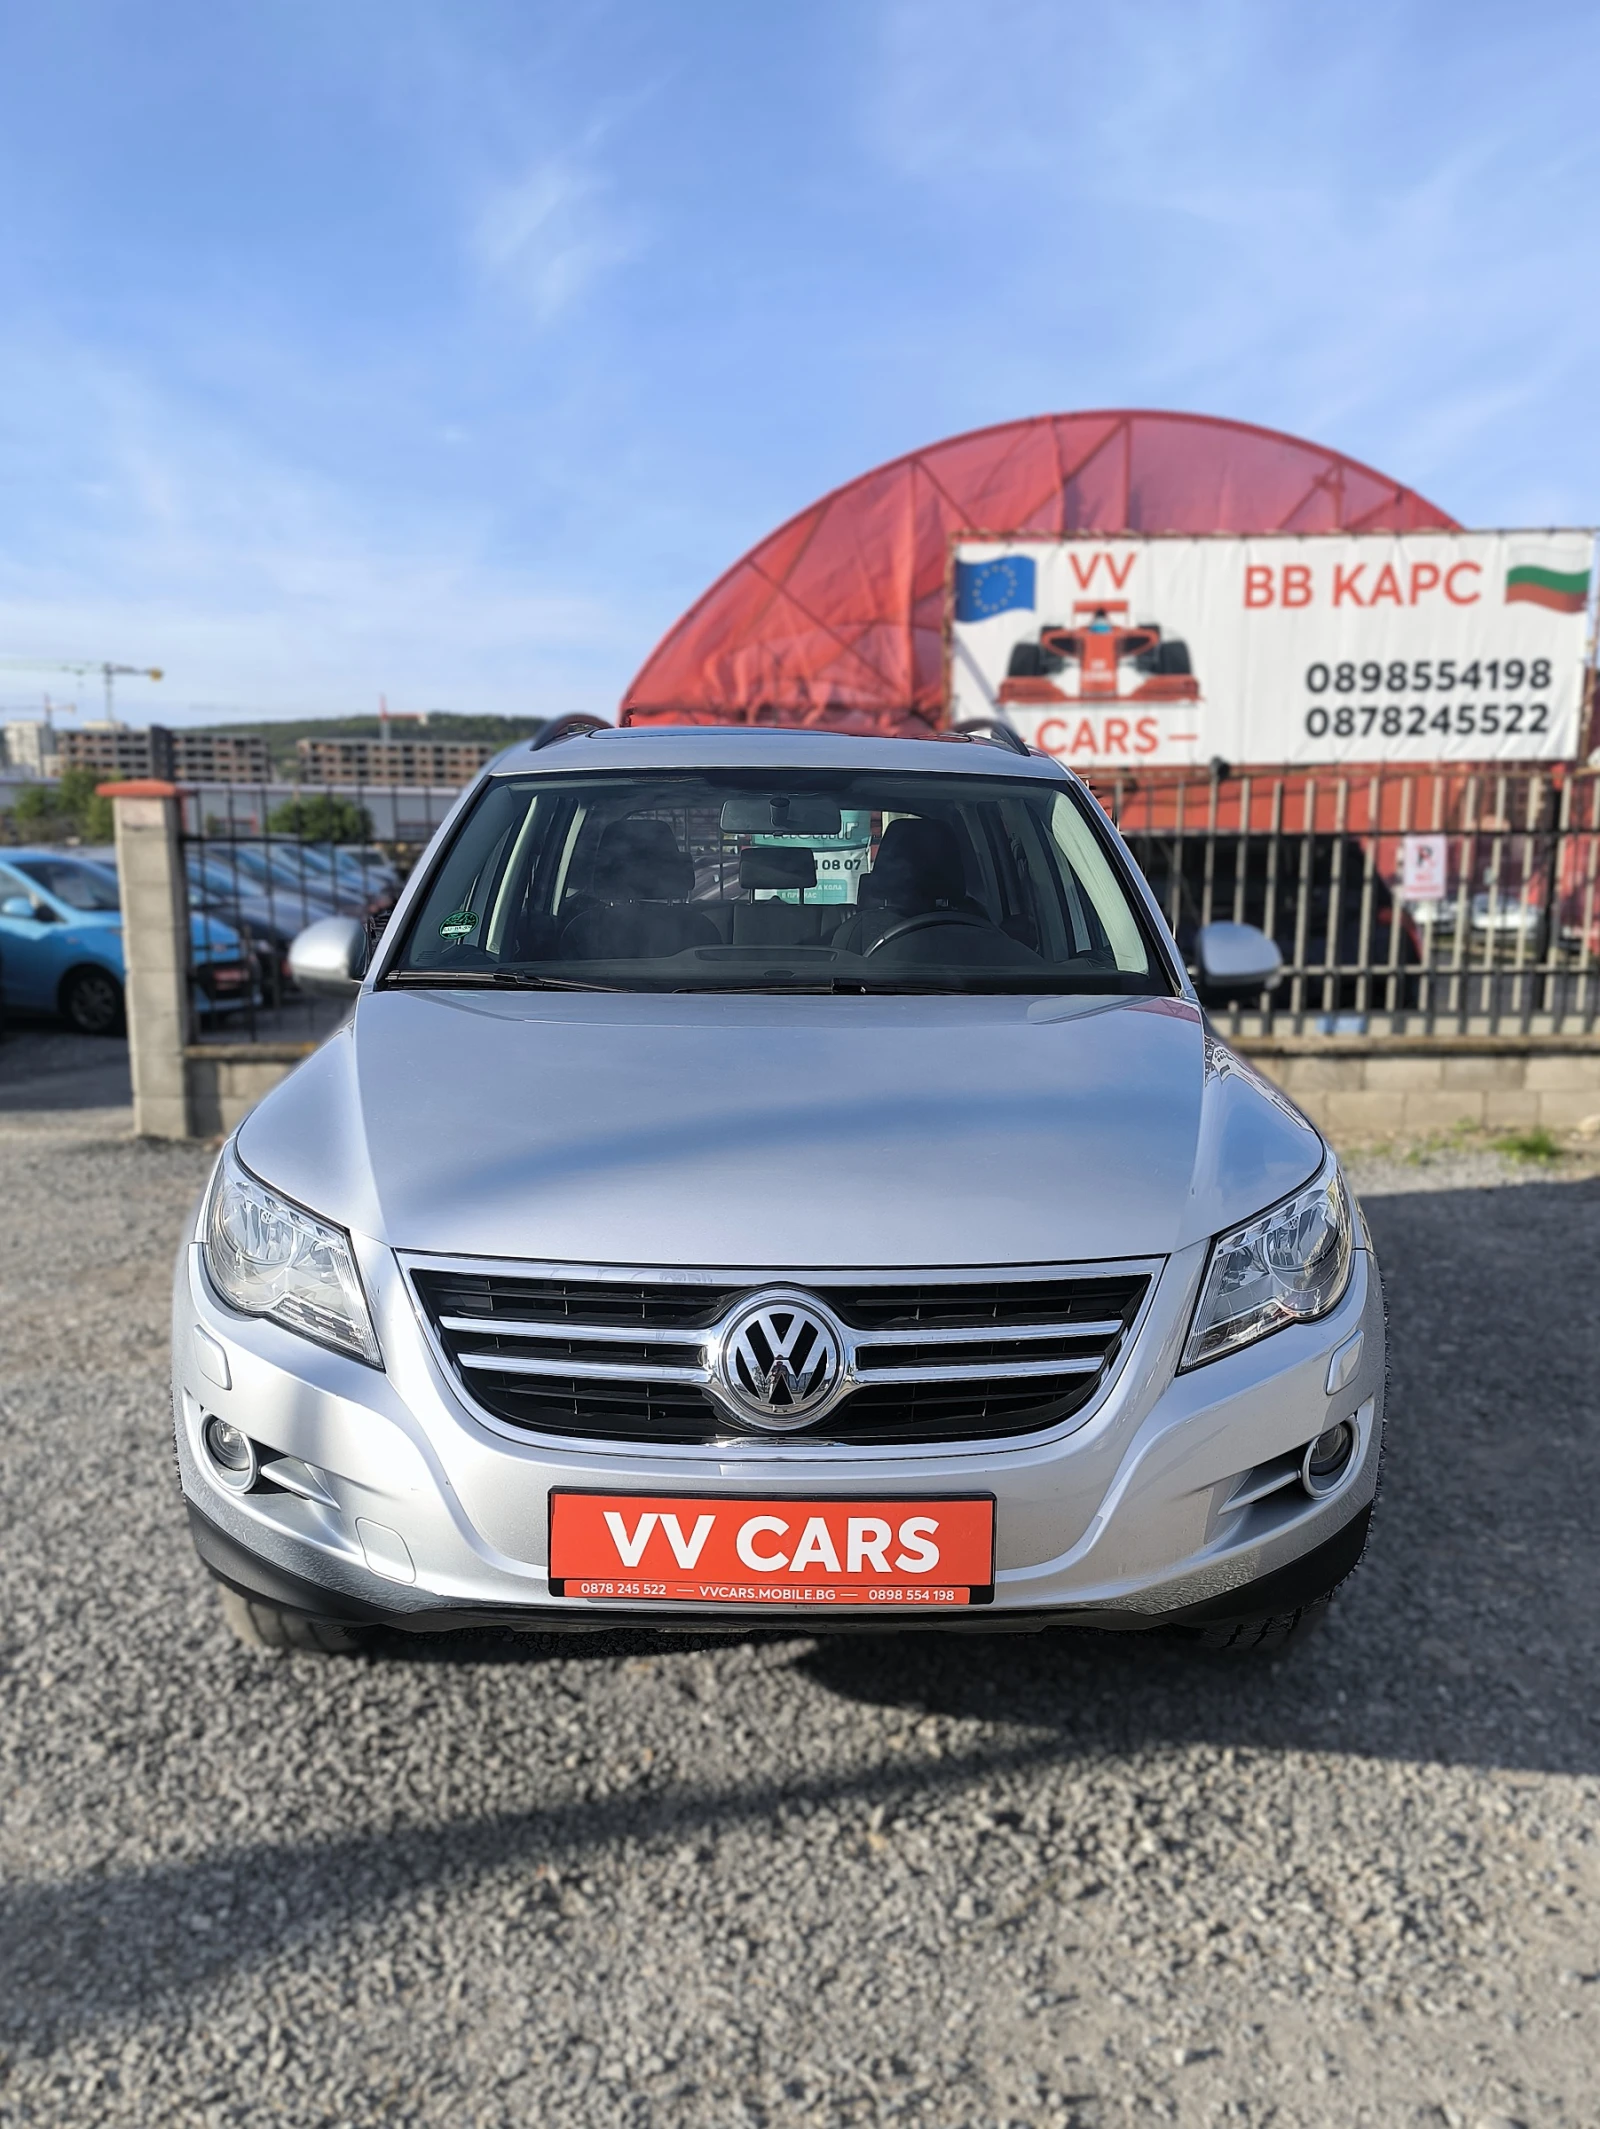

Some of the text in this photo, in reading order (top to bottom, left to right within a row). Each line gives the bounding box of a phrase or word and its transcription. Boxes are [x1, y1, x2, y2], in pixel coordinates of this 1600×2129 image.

[1069, 553, 1135, 590] VV
[1243, 560, 1481, 609] ВВ КАРС
[1306, 659, 1551, 694] 0898554198
[1036, 717, 1159, 755] CARS
[1306, 704, 1548, 738] 0878245522
[821, 859, 841, 871] 08
[844, 859, 862, 871] 07
[602, 1511, 940, 1574] VV CARS
[580, 1582, 955, 1601] 0878 245 522 VVCARS.MOBILE.BG 0898 554 198
